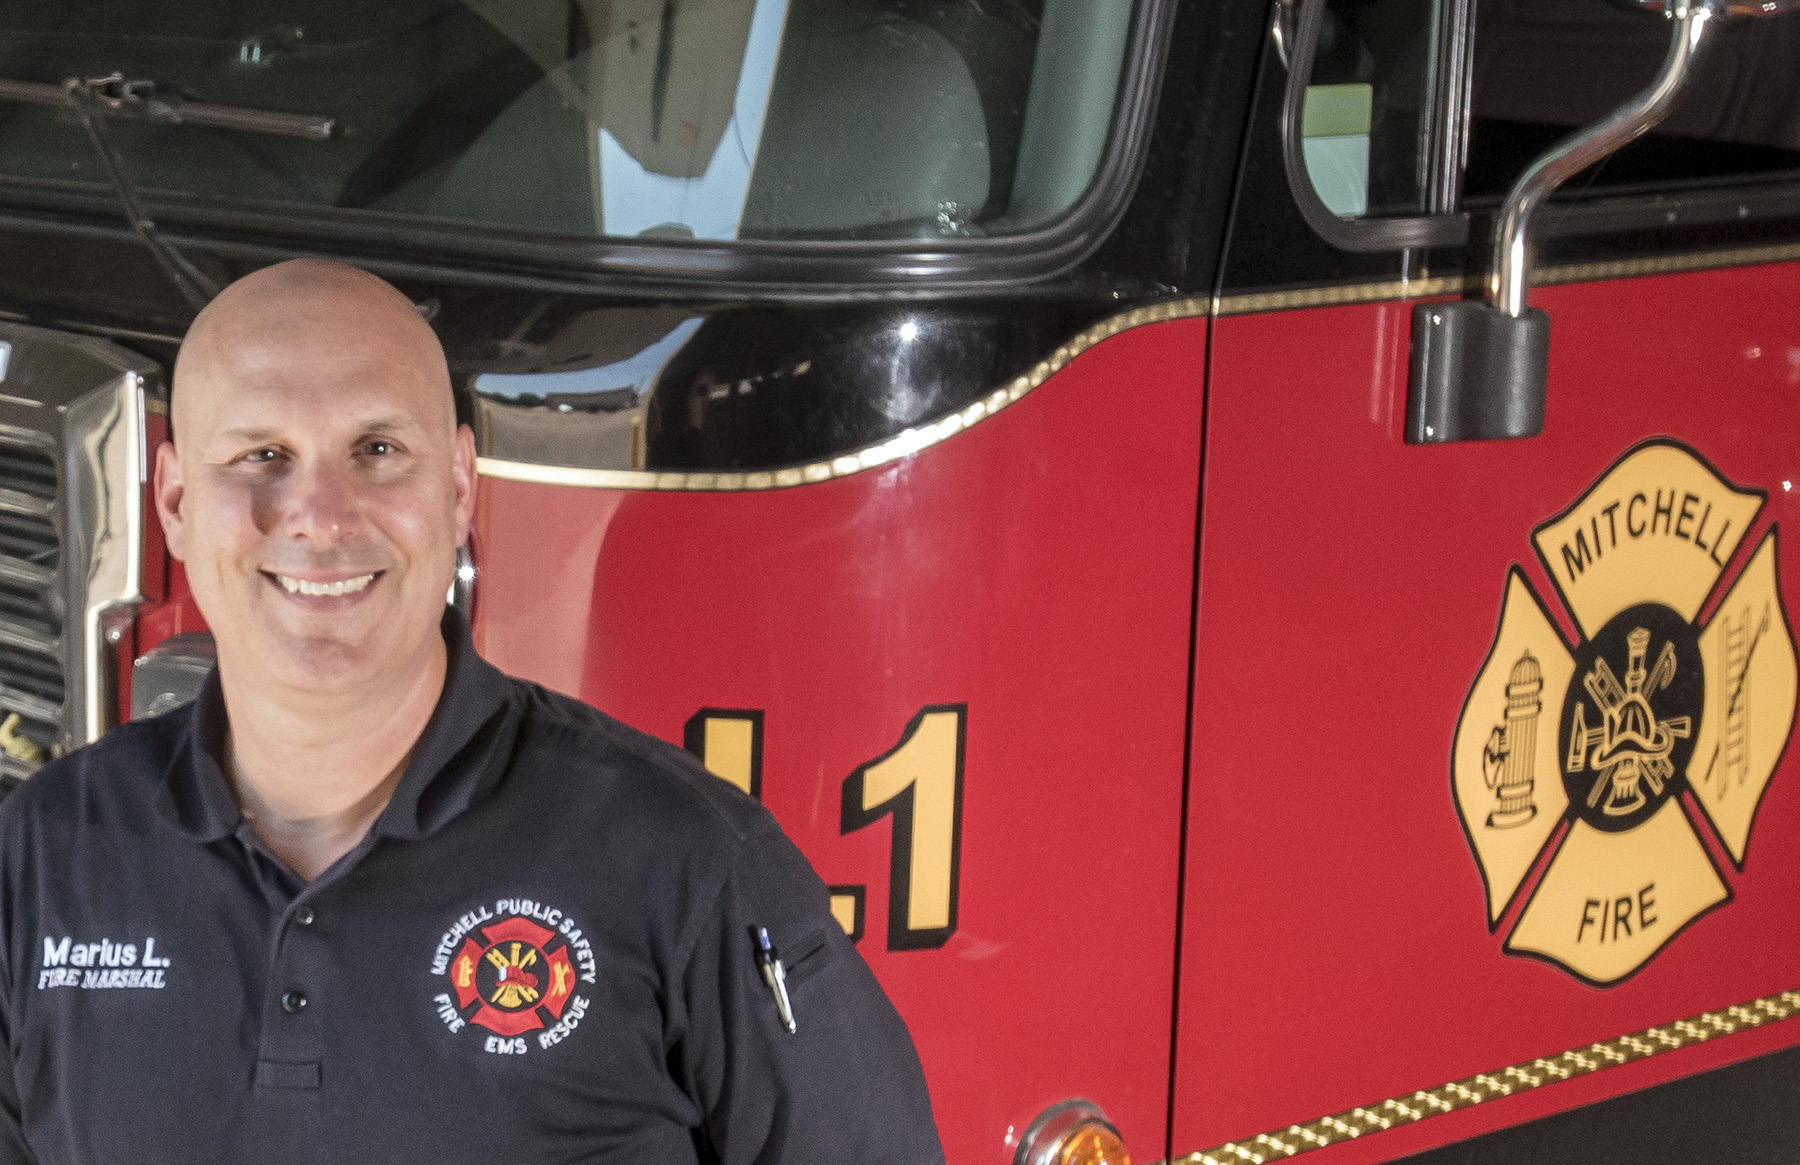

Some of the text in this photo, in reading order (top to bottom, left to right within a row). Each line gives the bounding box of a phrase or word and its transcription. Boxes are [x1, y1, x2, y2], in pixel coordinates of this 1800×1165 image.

[1560, 488, 1732, 583] MITCHELL
[429, 898, 597, 985] MITCHELL PUBLIC SAFETY
[1576, 882, 1658, 944] FIRE
[37, 967, 166, 990] FIRE MARSHAL
[43, 935, 171, 968] Marius L.
[433, 993, 591, 1055] FIRE EMS RESCUE
